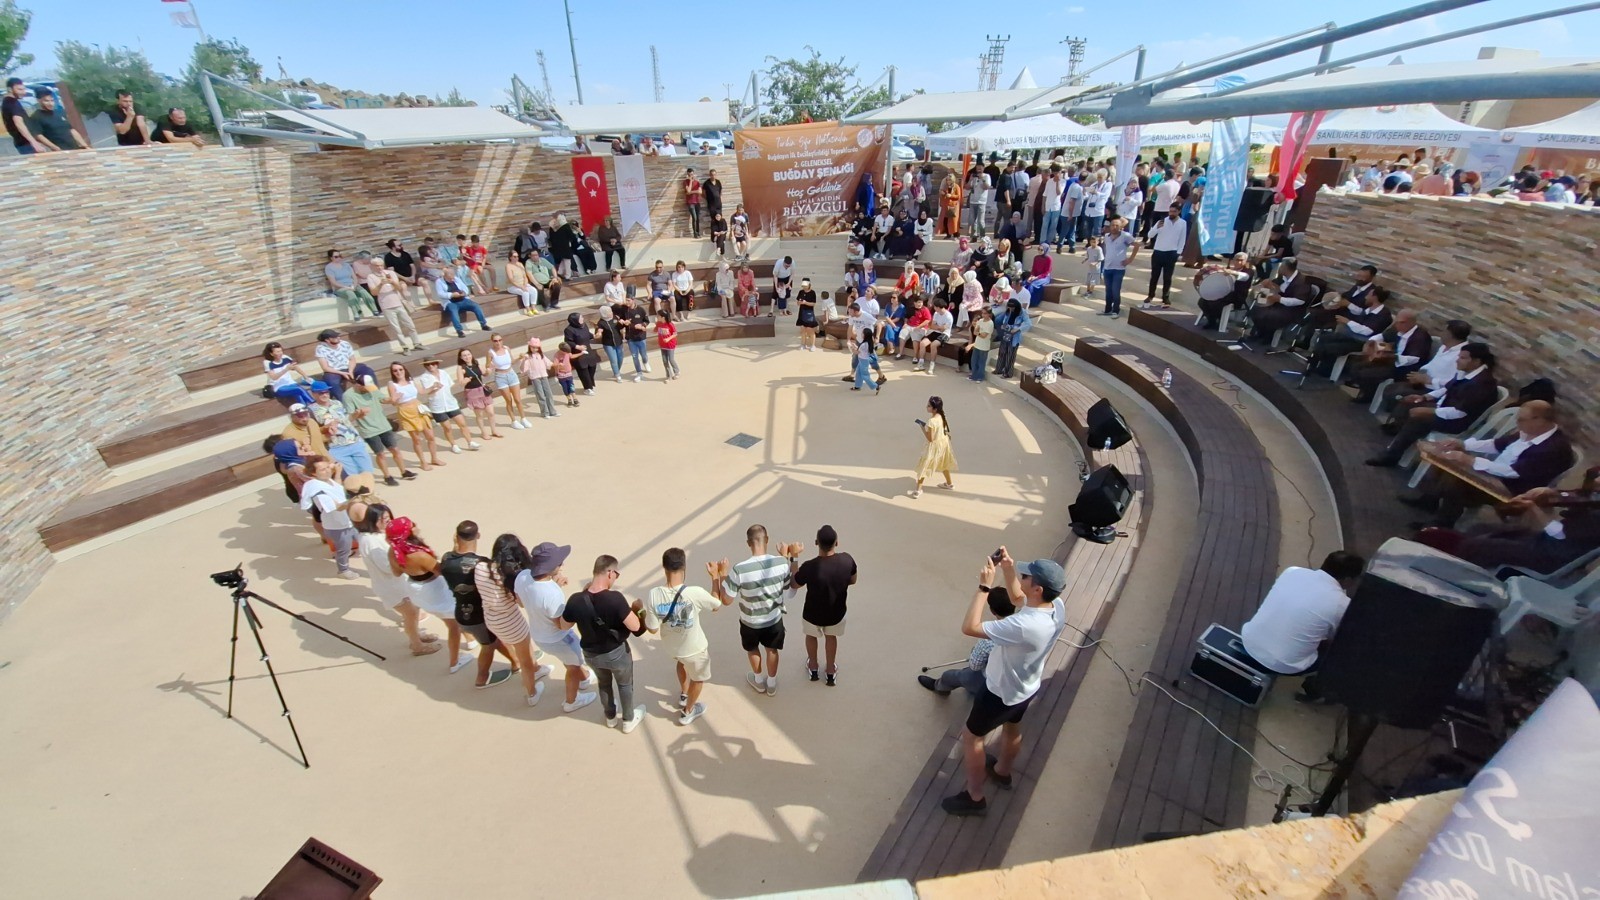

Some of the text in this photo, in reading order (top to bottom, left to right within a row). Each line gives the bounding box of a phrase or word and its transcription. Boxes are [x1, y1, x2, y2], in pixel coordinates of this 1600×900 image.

[1316, 130, 1359, 140] ŞANLIURFA
[801, 158, 832, 167] GELENEKSEL
[773, 162, 854, 182] BUĞDAY ŞENLİĞİ
[786, 181, 842, 198] Hoş Geldiniz
[783, 200, 848, 216] BEYAZGÜL
